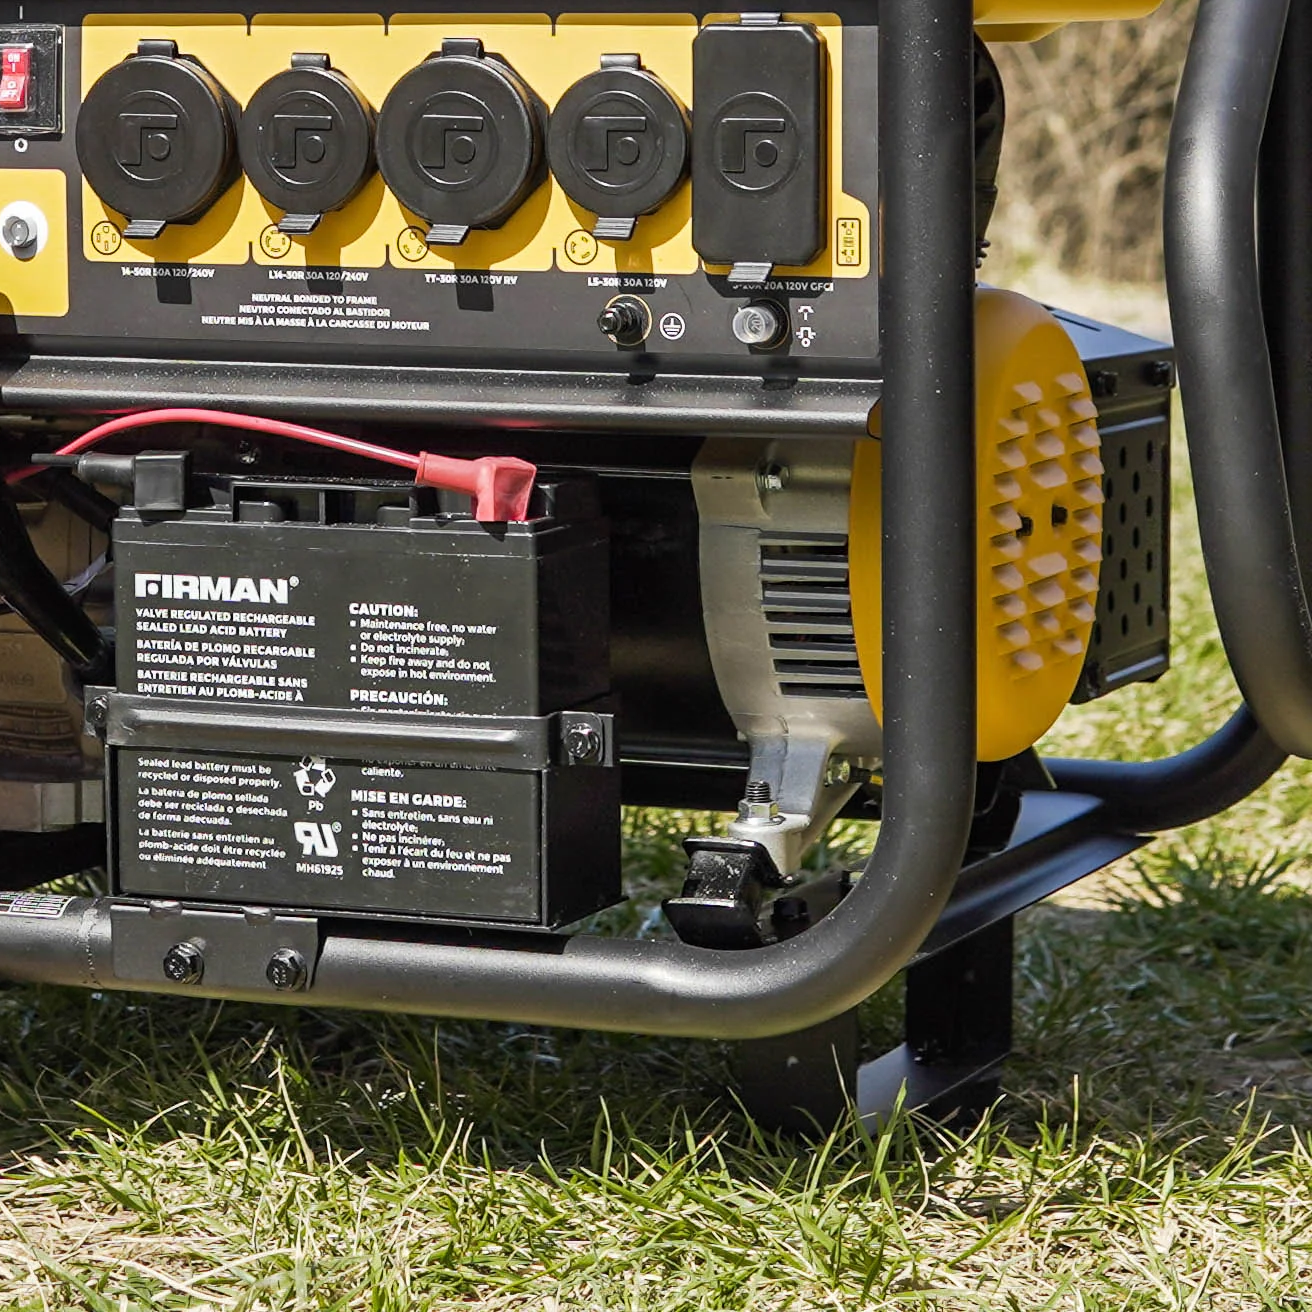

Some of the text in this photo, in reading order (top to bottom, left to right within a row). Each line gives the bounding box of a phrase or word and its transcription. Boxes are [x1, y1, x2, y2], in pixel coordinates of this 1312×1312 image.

[424, 273, 518, 285] TT-30R 30A 120V RV
[623, 278, 643, 288] 30A
[644, 278, 668, 289] 120V
[786, 282, 808, 290] 120V
[252, 294, 378, 305] NEUTRAL BONDED TO FRAME
[239, 305, 390, 317] NEUTRO CONECTADO AL BASTIDOR
[201, 315, 430, 330] NEUTRE MIS À LA MASSE À LA CARCASSE DU MOTEUR
[136, 608, 315, 626] VALVE REGULATED RECHARGEABLE
[349, 603, 419, 617] CAUTION:
[136, 622, 287, 638] SEALED LEAD ACID BATTERY
[360, 618, 425, 631] Maintenance
[451, 624, 465, 633] no
[467, 625, 496, 634] water
[360, 631, 371, 640] or
[373, 631, 426, 647] electrolyte
[137, 639, 315, 658] BATERÍA DE PLOMO RECARGABLE
[360, 643, 374, 652] Do
[377, 644, 394, 653] not
[137, 653, 277, 669] REGULADA POR VÁLVULAS
[360, 655, 490, 671] Keep fire away and do not
[137, 669, 308, 688] BATTERIE RECHARGEABLE SANS
[360, 668, 496, 683] expose in hot environment.
[138, 683, 304, 702] ENTRETIEN AU PLOMB-ACIDE À
[350, 689, 449, 706] PRECAUCIÓN:
[138, 757, 271, 774] Sealed lead battery must be
[138, 770, 282, 789] recycled or disposed properly.
[187, 790, 199, 799] de
[202, 791, 233, 801] plomo
[235, 793, 269, 803] sellada
[351, 789, 467, 808] MISE EN GARDE:
[138, 799, 162, 808] debe
[164, 801, 179, 809] ser
[181, 802, 224, 812] reciclada
[236, 805, 288, 817] desechada
[308, 800, 324, 811] Pb
[138, 811, 232, 825] de forma adecuada.
[362, 808, 385, 819] Sans
[438, 814, 460, 824] sans
[463, 816, 481, 825] eau
[483, 815, 494, 825] ni
[362, 832, 376, 842] Ne
[379, 834, 396, 844] pas
[296, 863, 343, 876] MH61925
